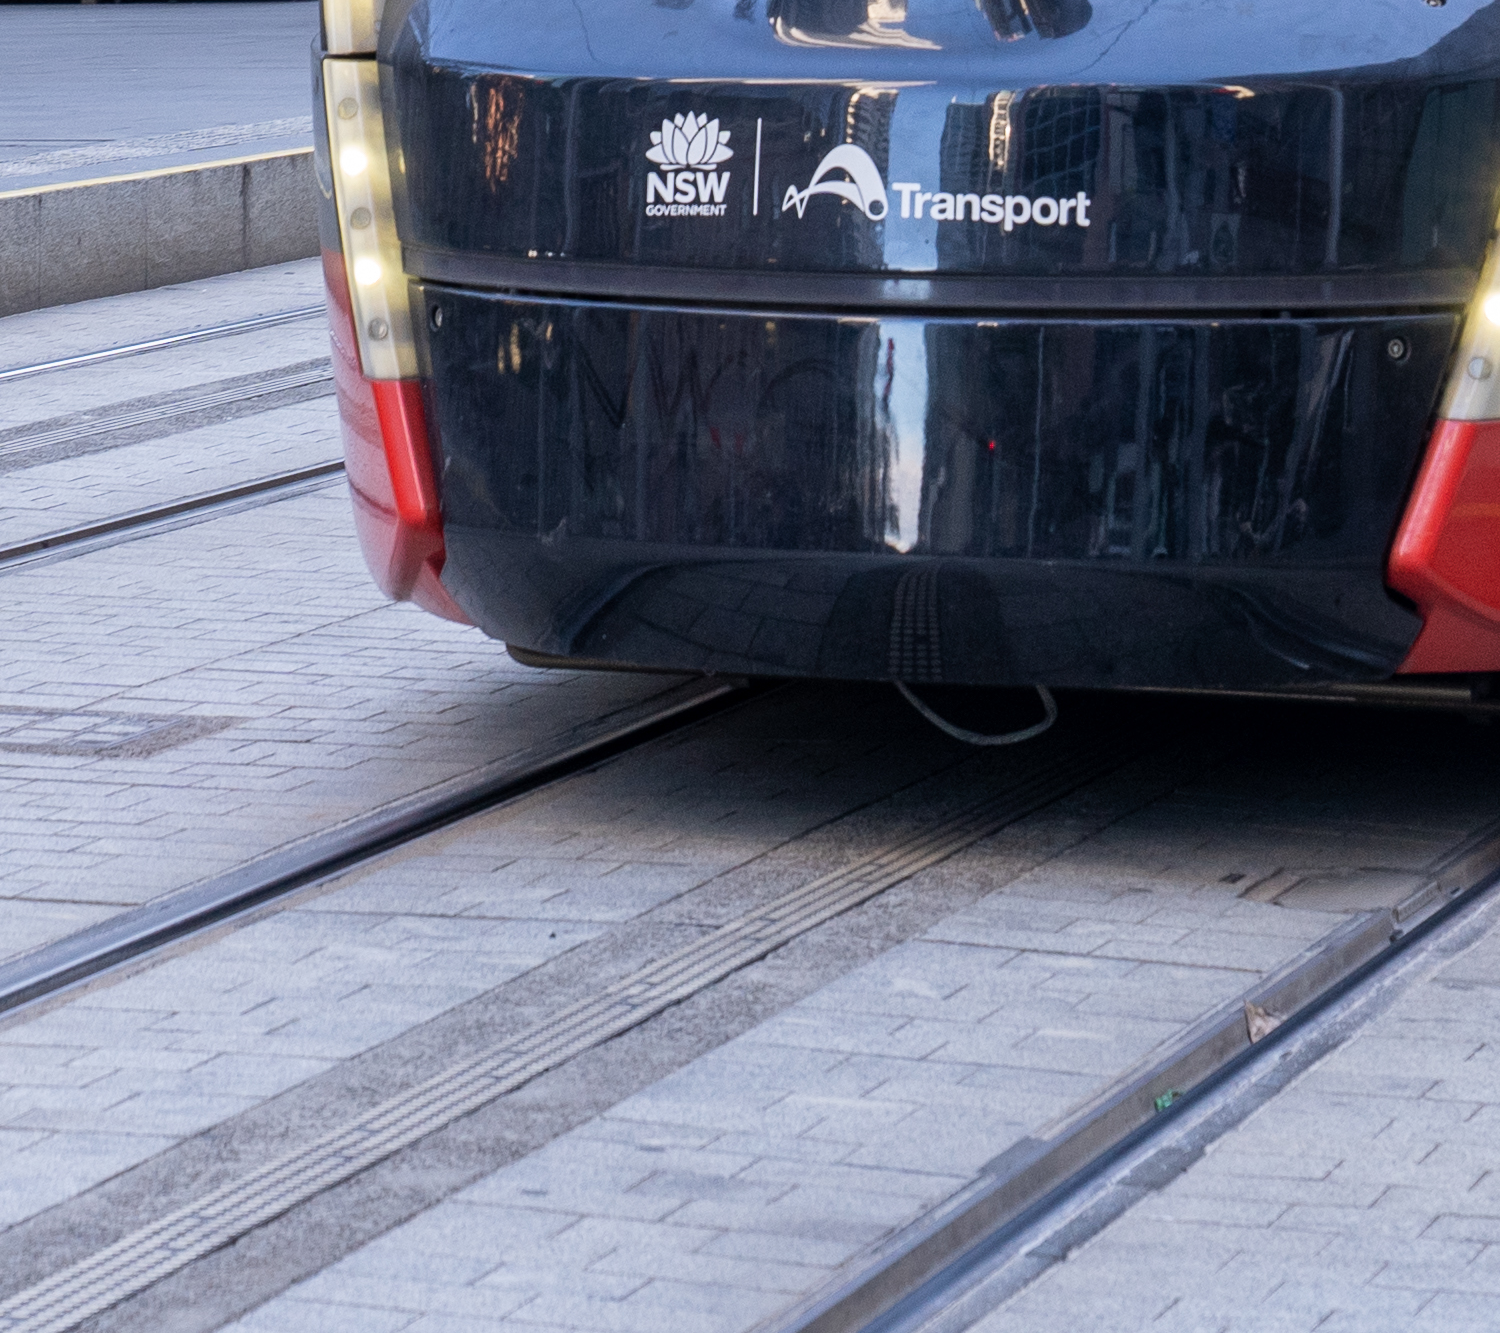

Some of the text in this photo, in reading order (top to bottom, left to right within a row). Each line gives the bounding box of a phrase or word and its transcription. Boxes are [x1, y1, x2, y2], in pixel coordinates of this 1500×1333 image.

[646, 171, 731, 204] NSW
[645, 203, 727, 217] GOVERNMENT
[892, 182, 1092, 231] Transport
